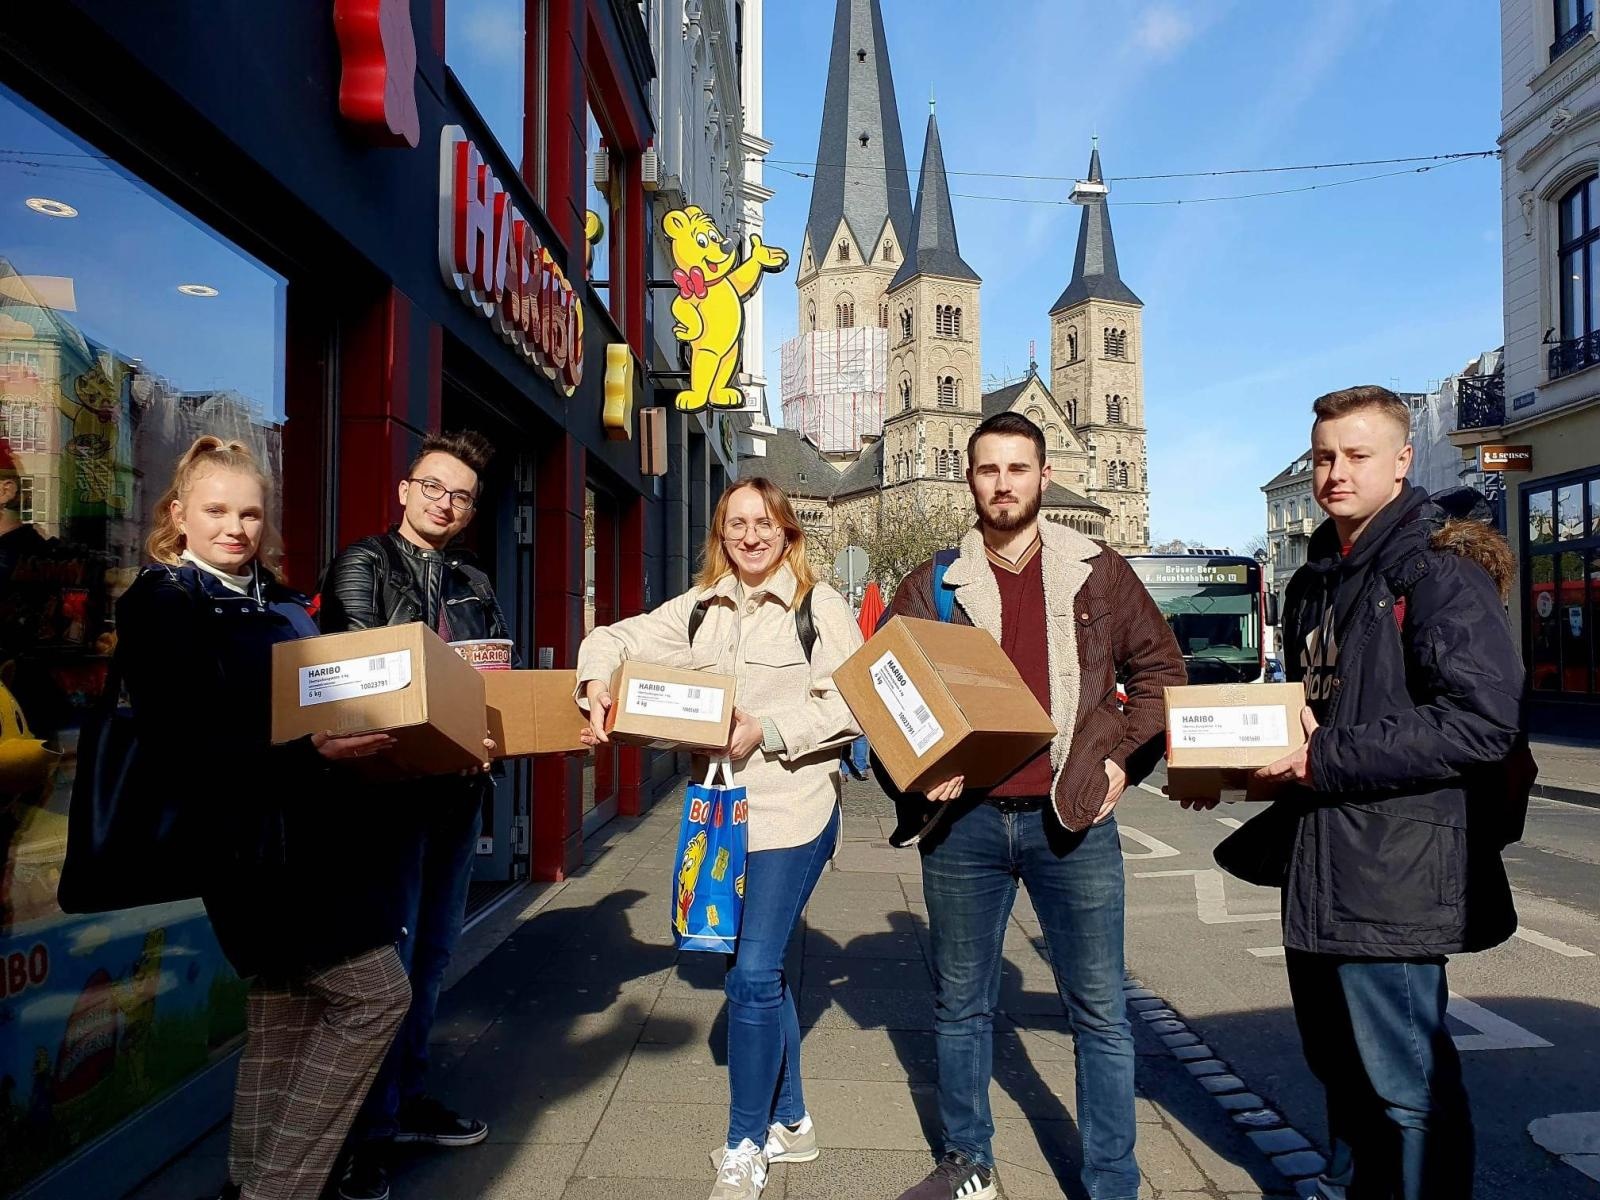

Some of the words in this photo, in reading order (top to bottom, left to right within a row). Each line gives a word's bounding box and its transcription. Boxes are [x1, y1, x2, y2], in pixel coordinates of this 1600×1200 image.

[454, 140, 585, 388] HARIBO
[1197, 565, 1217, 574] Berg
[1156, 574, 1213, 582] Hauptbahnhof
[473, 650, 509, 661] HARIBO
[308, 666, 341, 678] HARIBO
[887, 660, 907, 687] HARIBO
[360, 680, 388, 690] 10023791
[877, 676, 883, 685] kg
[638, 683, 665, 692] HARIBO
[1182, 715, 1214, 723] HARIBO
